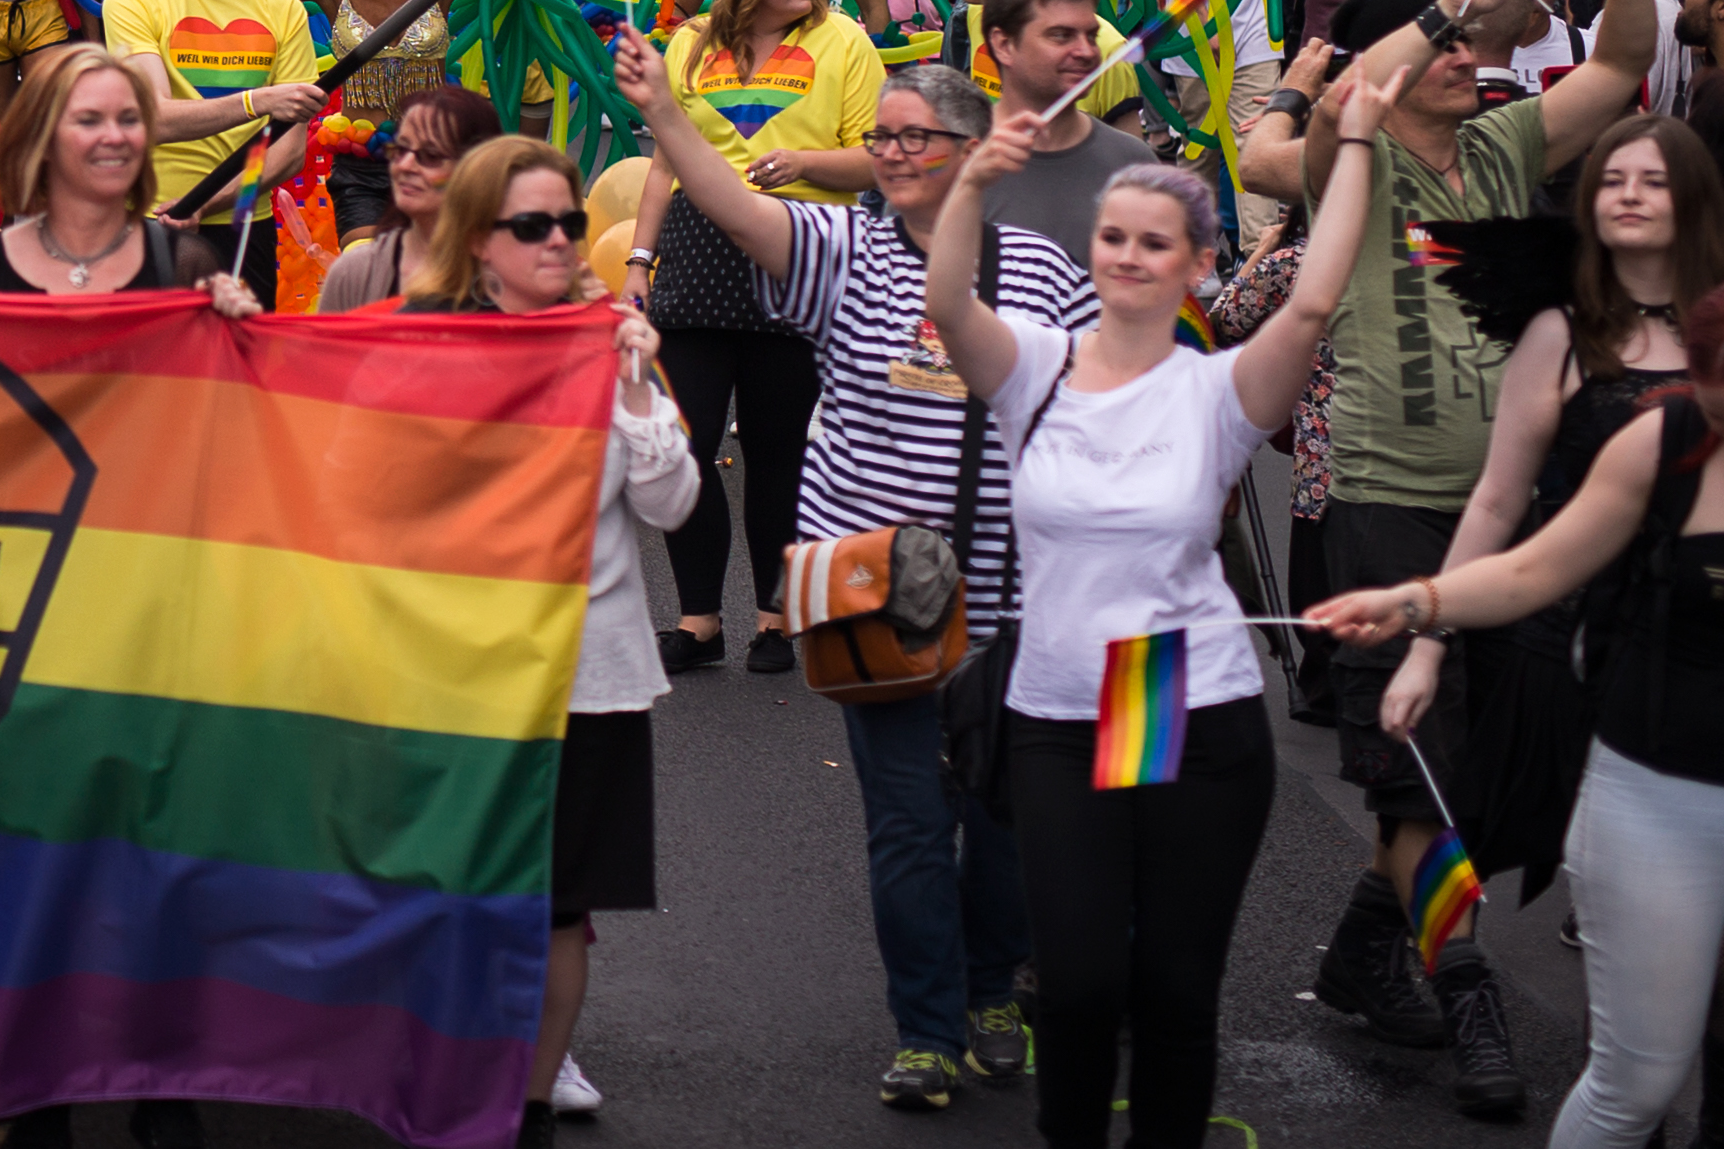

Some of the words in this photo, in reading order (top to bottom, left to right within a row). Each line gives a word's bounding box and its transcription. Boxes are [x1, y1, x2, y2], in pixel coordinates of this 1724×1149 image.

[177, 54, 200, 64] WEIL
[202, 55, 219, 65] WIR
[222, 56, 245, 66] DICH
[774, 77, 809, 91] LIEBEN
